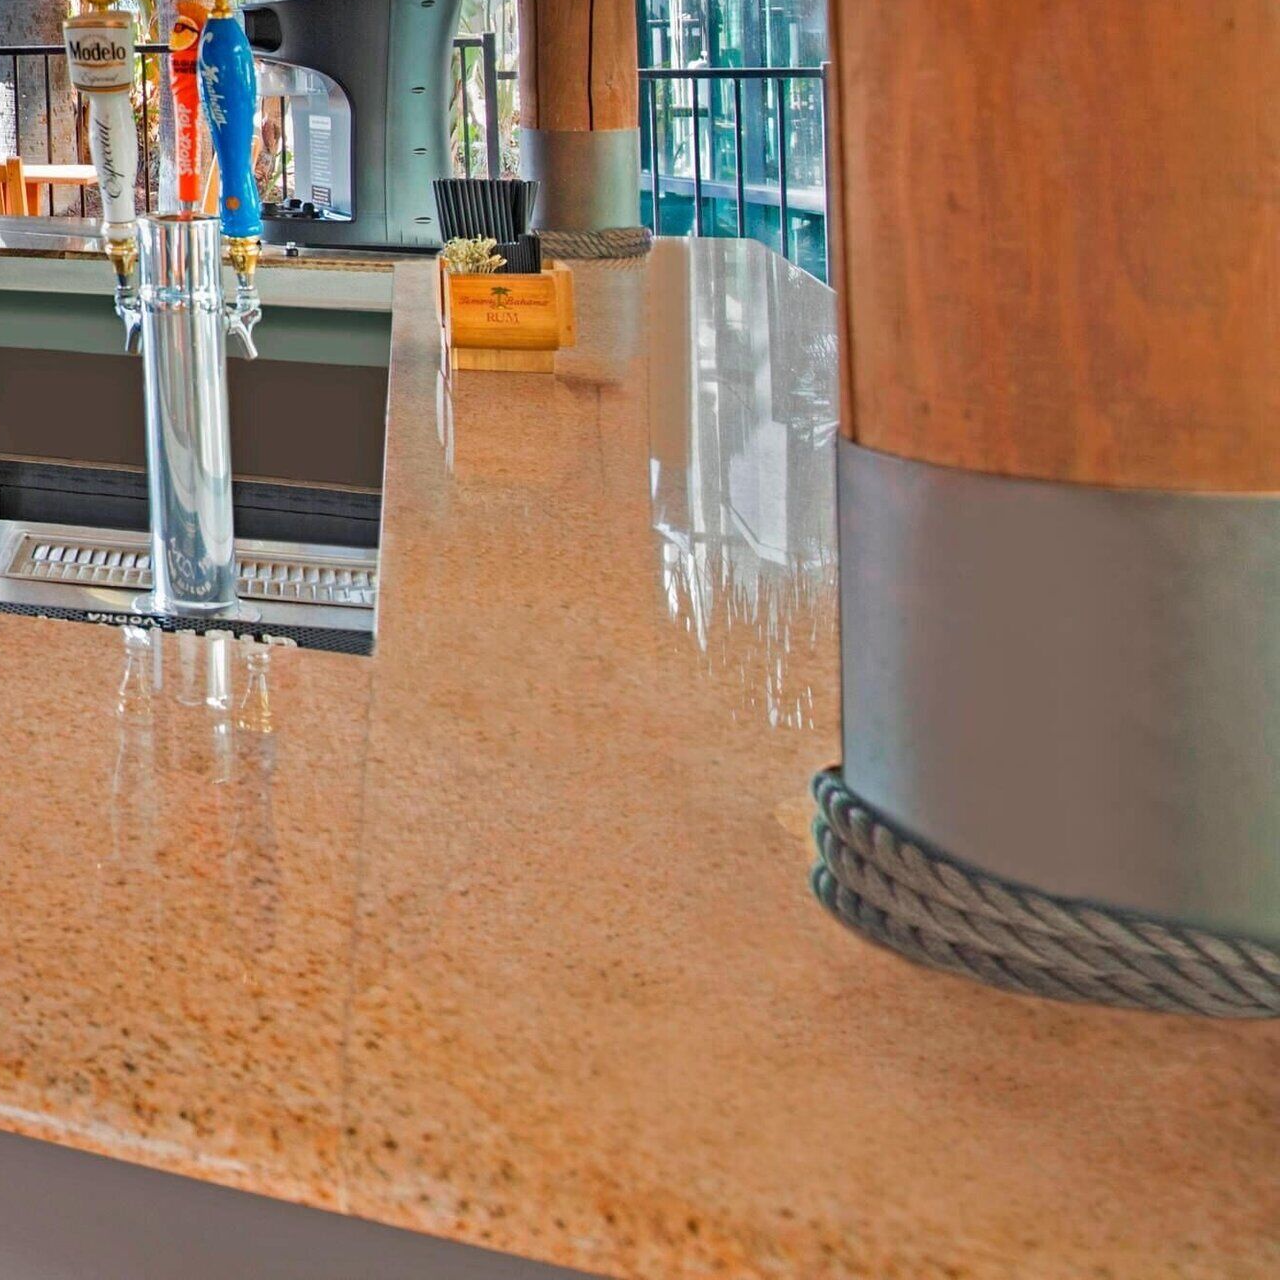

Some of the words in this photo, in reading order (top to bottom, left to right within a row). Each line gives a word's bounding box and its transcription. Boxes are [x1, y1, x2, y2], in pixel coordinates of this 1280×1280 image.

[69, 41, 127, 61] Modelo
[95, 119, 125, 202] Especial
[487, 312, 519, 323] RUM
[87, 612, 154, 627] VODKA
